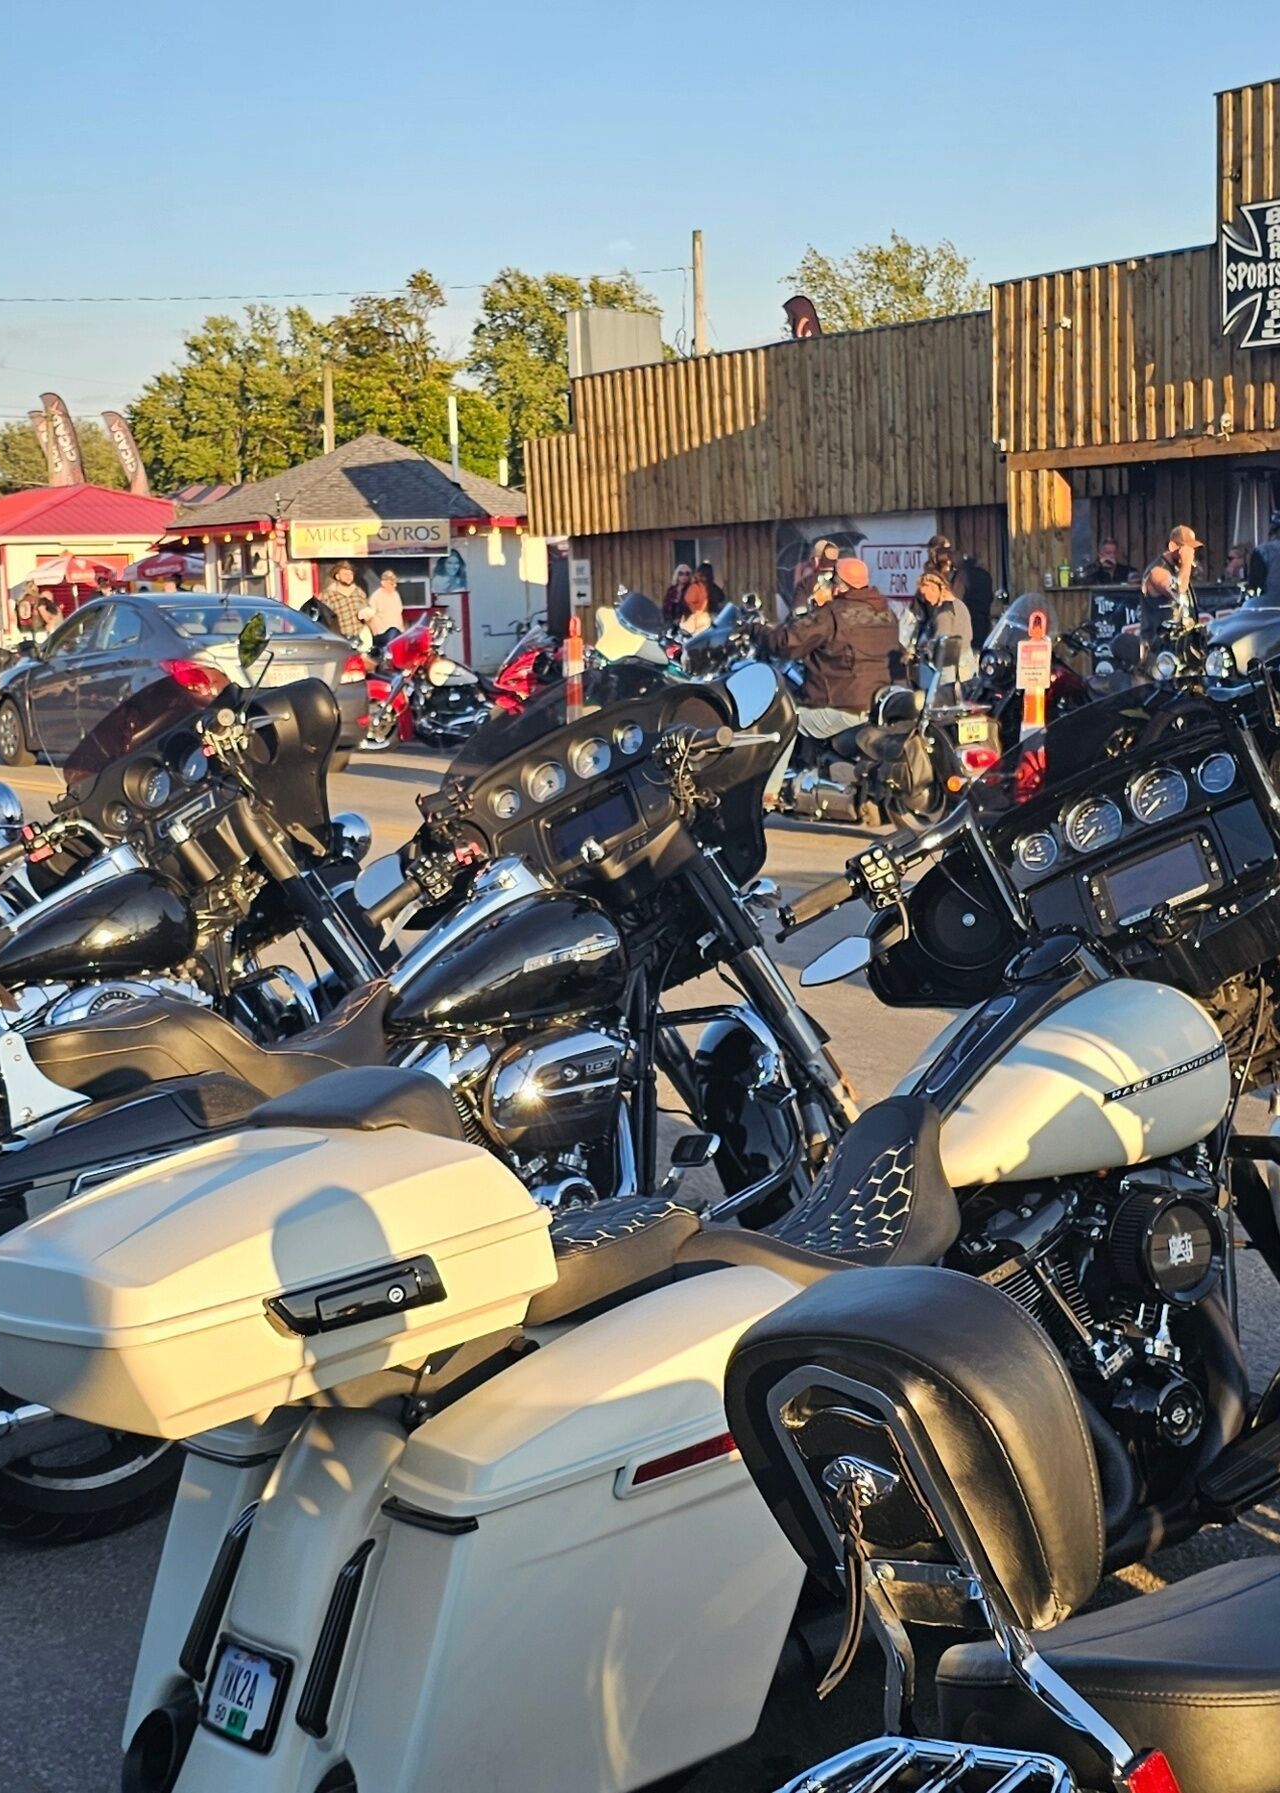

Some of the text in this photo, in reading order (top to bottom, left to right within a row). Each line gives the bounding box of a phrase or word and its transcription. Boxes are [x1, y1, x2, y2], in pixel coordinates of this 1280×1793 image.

[110, 418, 138, 474] CICADA
[305, 525, 441, 543] MIKES GYROS
[877, 550, 922, 570] LOOK OUT
[889, 573, 909, 593] FOR
